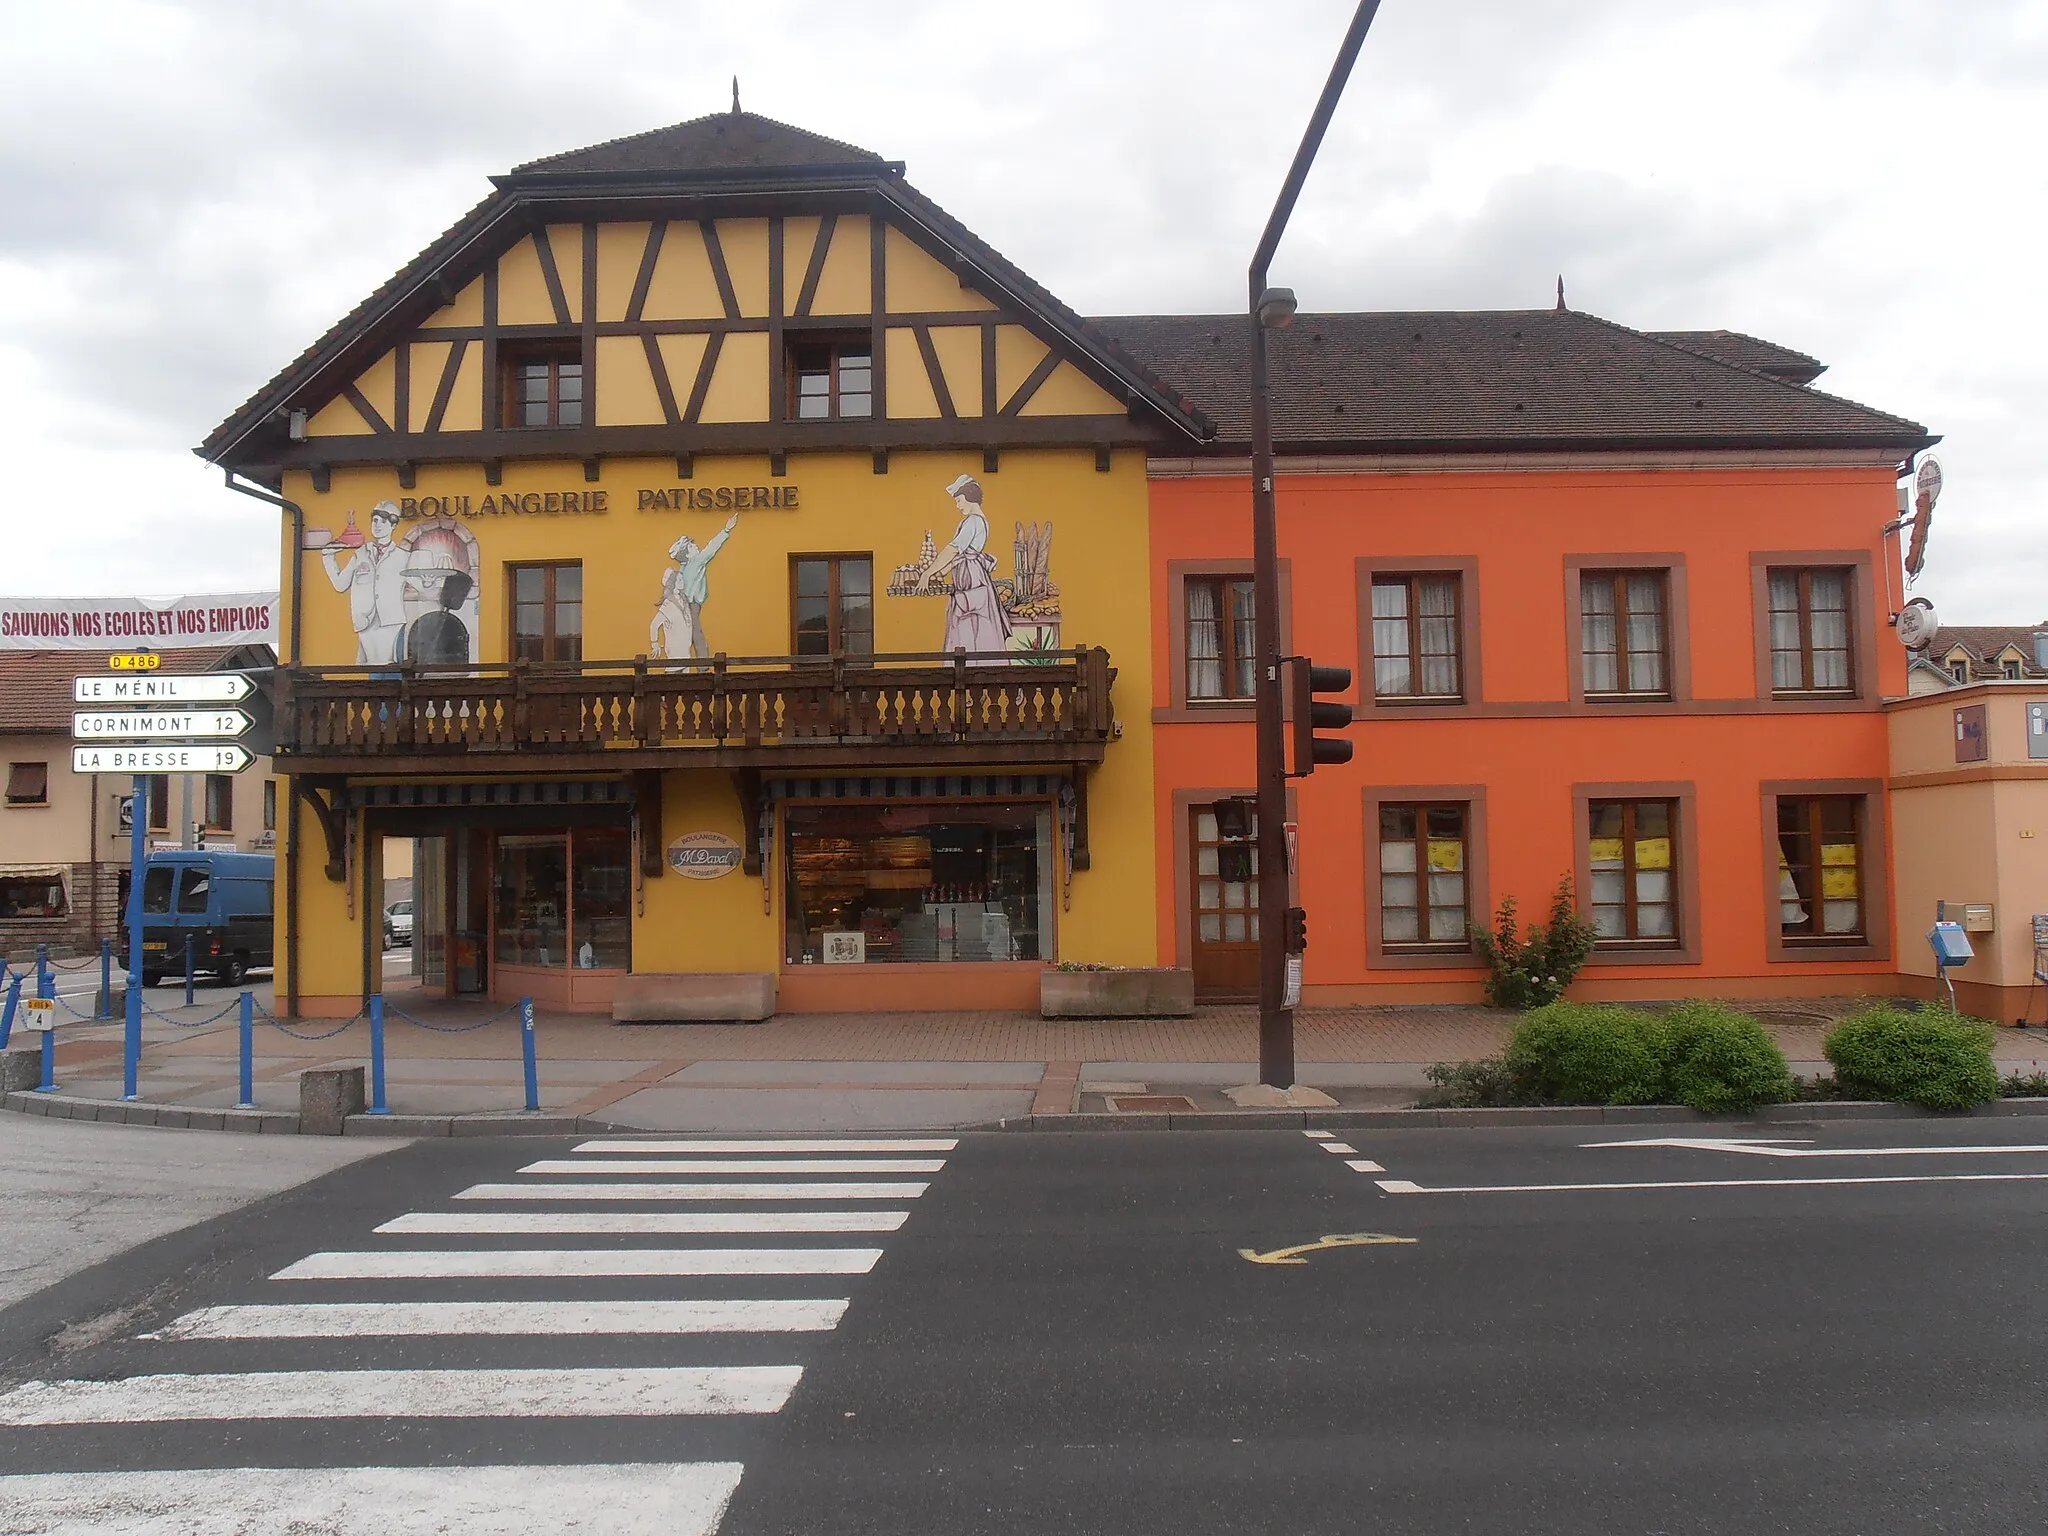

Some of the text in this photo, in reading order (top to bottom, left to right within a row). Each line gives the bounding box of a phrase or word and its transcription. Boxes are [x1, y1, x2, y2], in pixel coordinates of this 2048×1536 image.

[400, 486, 799, 519] BOULANGERIE PATISSERIE
[2, 605, 269, 636] SAUVONS NOS ECOLES ET NOS EMPLOIS
[113, 656, 155, 668] D 486
[81, 680, 236, 696] LE MÉNIL 3
[81, 717, 234, 732] CORNIMONT 12
[80, 752, 234, 767] LA BRESSE 19
[681, 834, 727, 845] BOULANGERIE
[36, 1013, 42, 1025] 4
